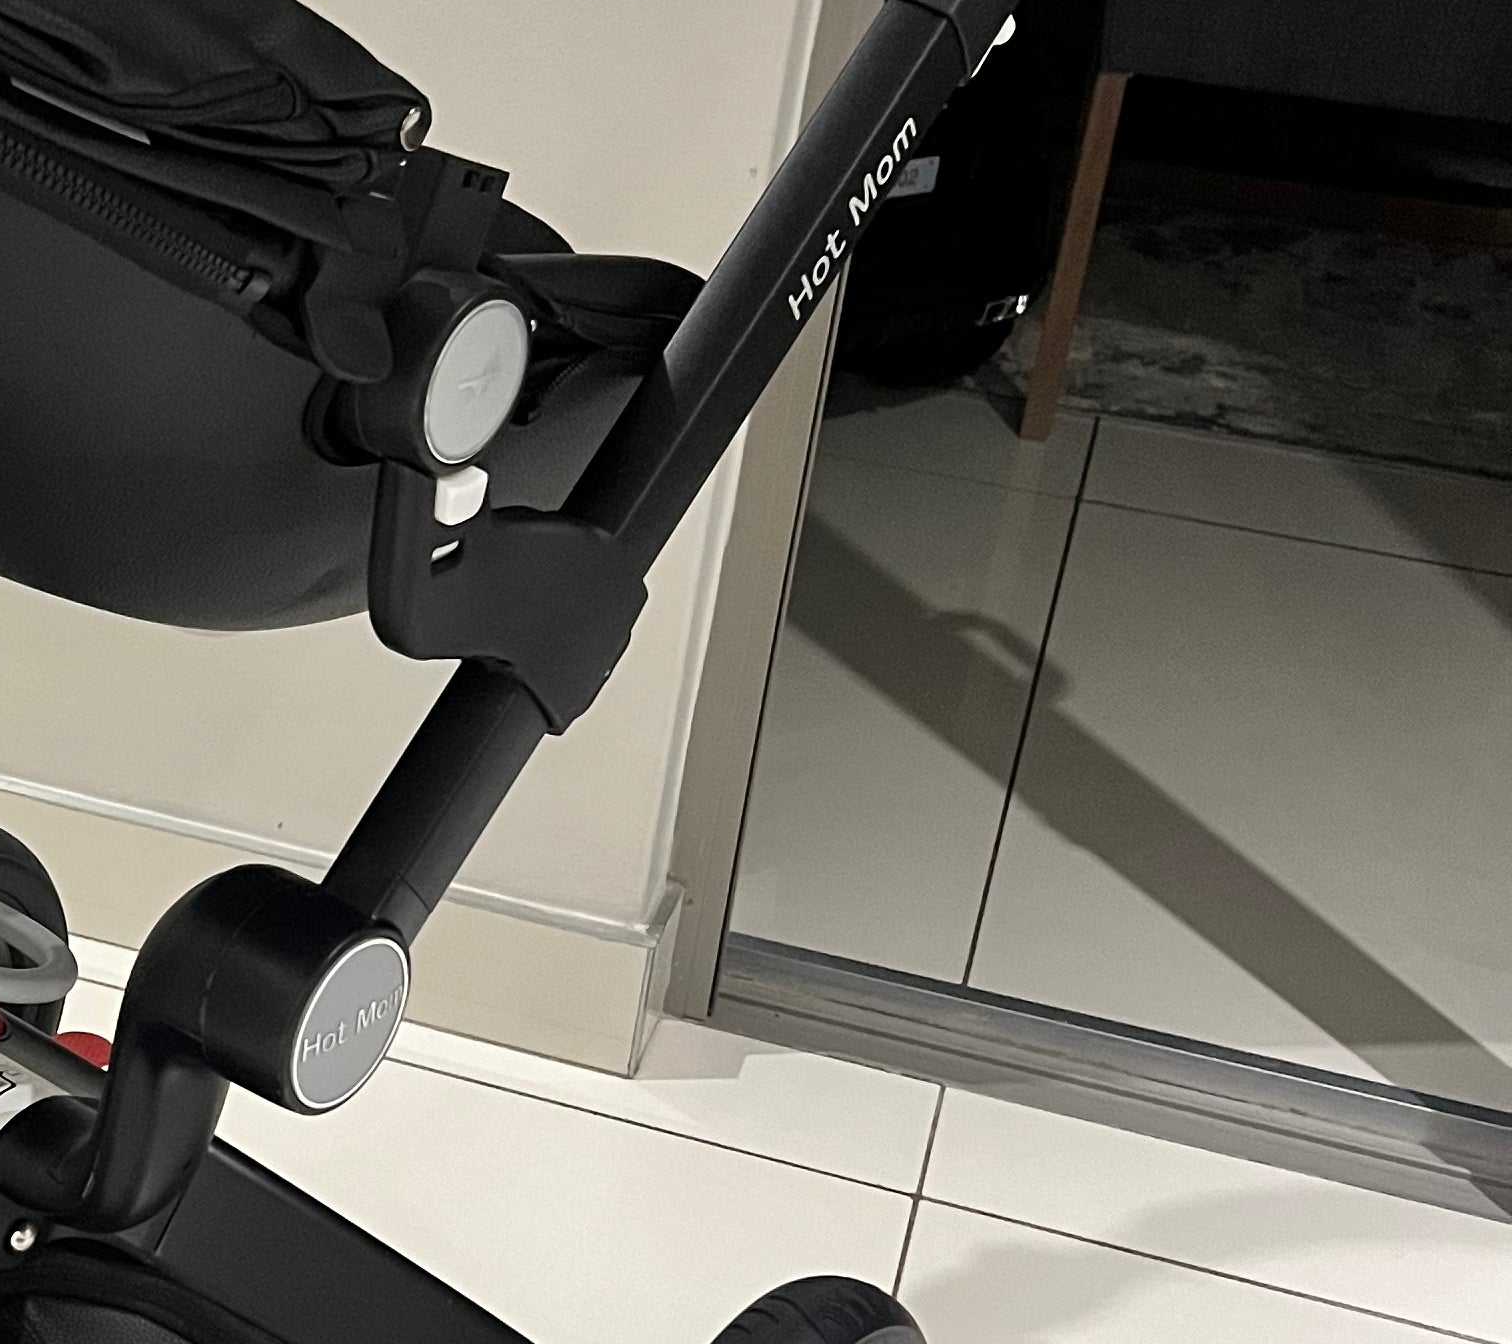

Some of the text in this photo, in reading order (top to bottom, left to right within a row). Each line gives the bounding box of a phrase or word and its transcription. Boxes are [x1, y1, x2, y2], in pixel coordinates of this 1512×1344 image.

[787, 117, 918, 320] Hot Mom
[302, 1021, 347, 1063] Hot
